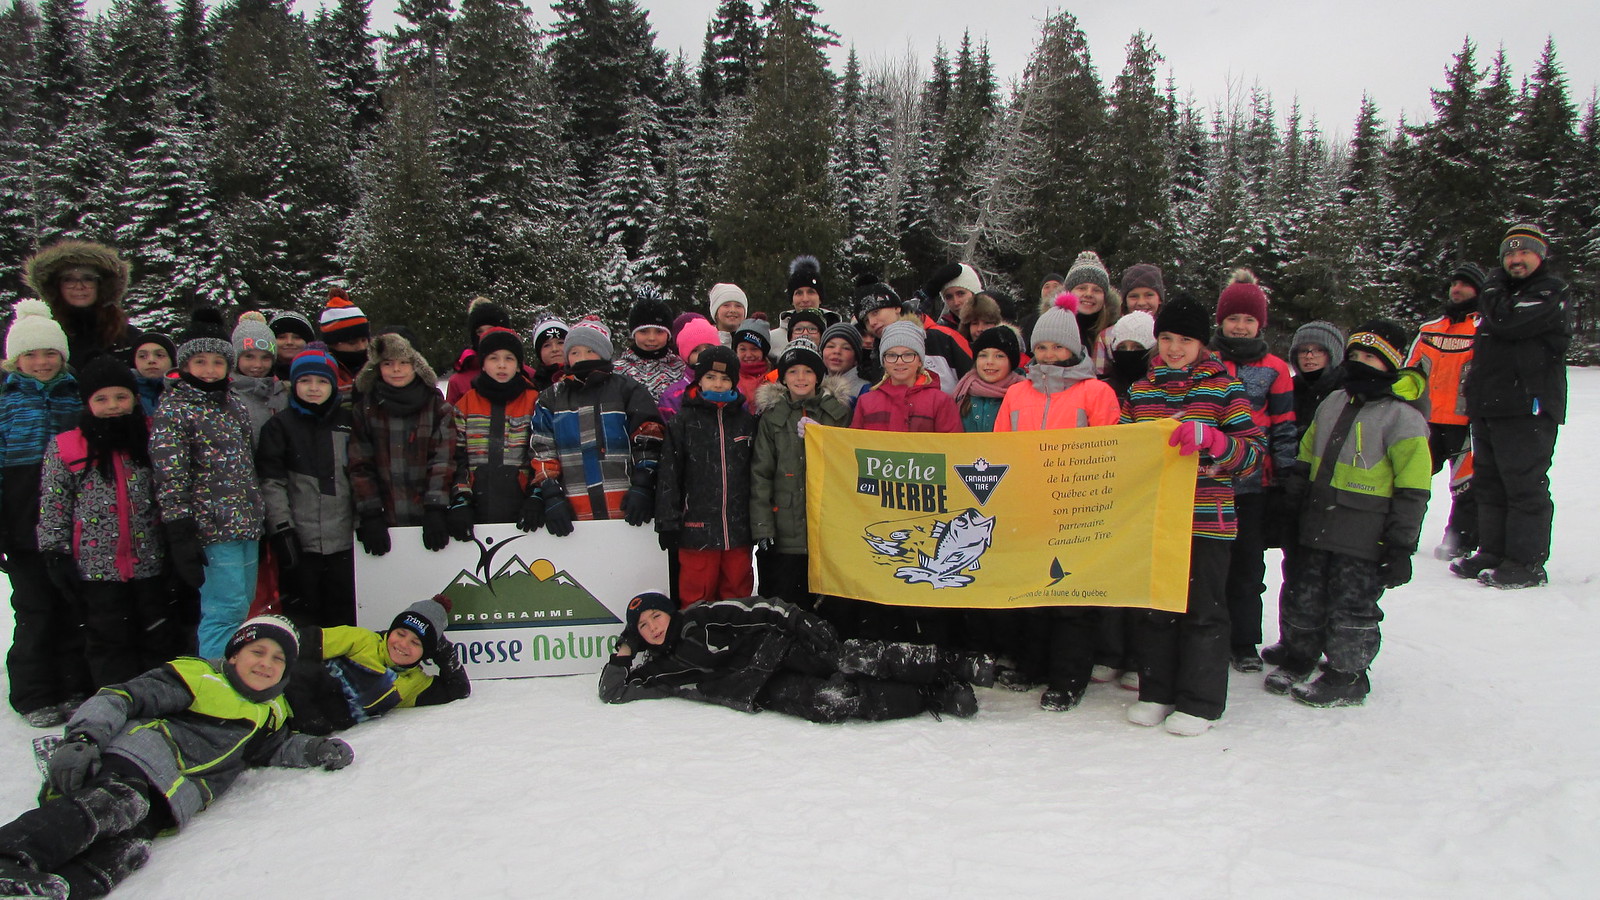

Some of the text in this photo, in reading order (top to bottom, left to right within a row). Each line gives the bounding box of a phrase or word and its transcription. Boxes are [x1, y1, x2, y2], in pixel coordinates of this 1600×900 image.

[1039, 438, 1118, 452] Une présentation
[1043, 454, 1116, 468] de la Fondation
[866, 456, 936, 481] Pêche
[965, 475, 998, 483] CANADIAN
[1046, 470, 1115, 485] de la faune du
[974, 483, 989, 491] TIRE
[1051, 485, 1113, 500] Québec et de
[860, 480, 948, 513] en HERBE
[1053, 500, 1114, 516] son principal
[1048, 535, 1091, 546] Canadian
[1043, 588, 1050, 597] la
[1051, 588, 1070, 597] faune
[1071, 588, 1080, 597] du
[454, 609, 574, 621] PROGRAMME
[440, 639, 523, 665] nesse
